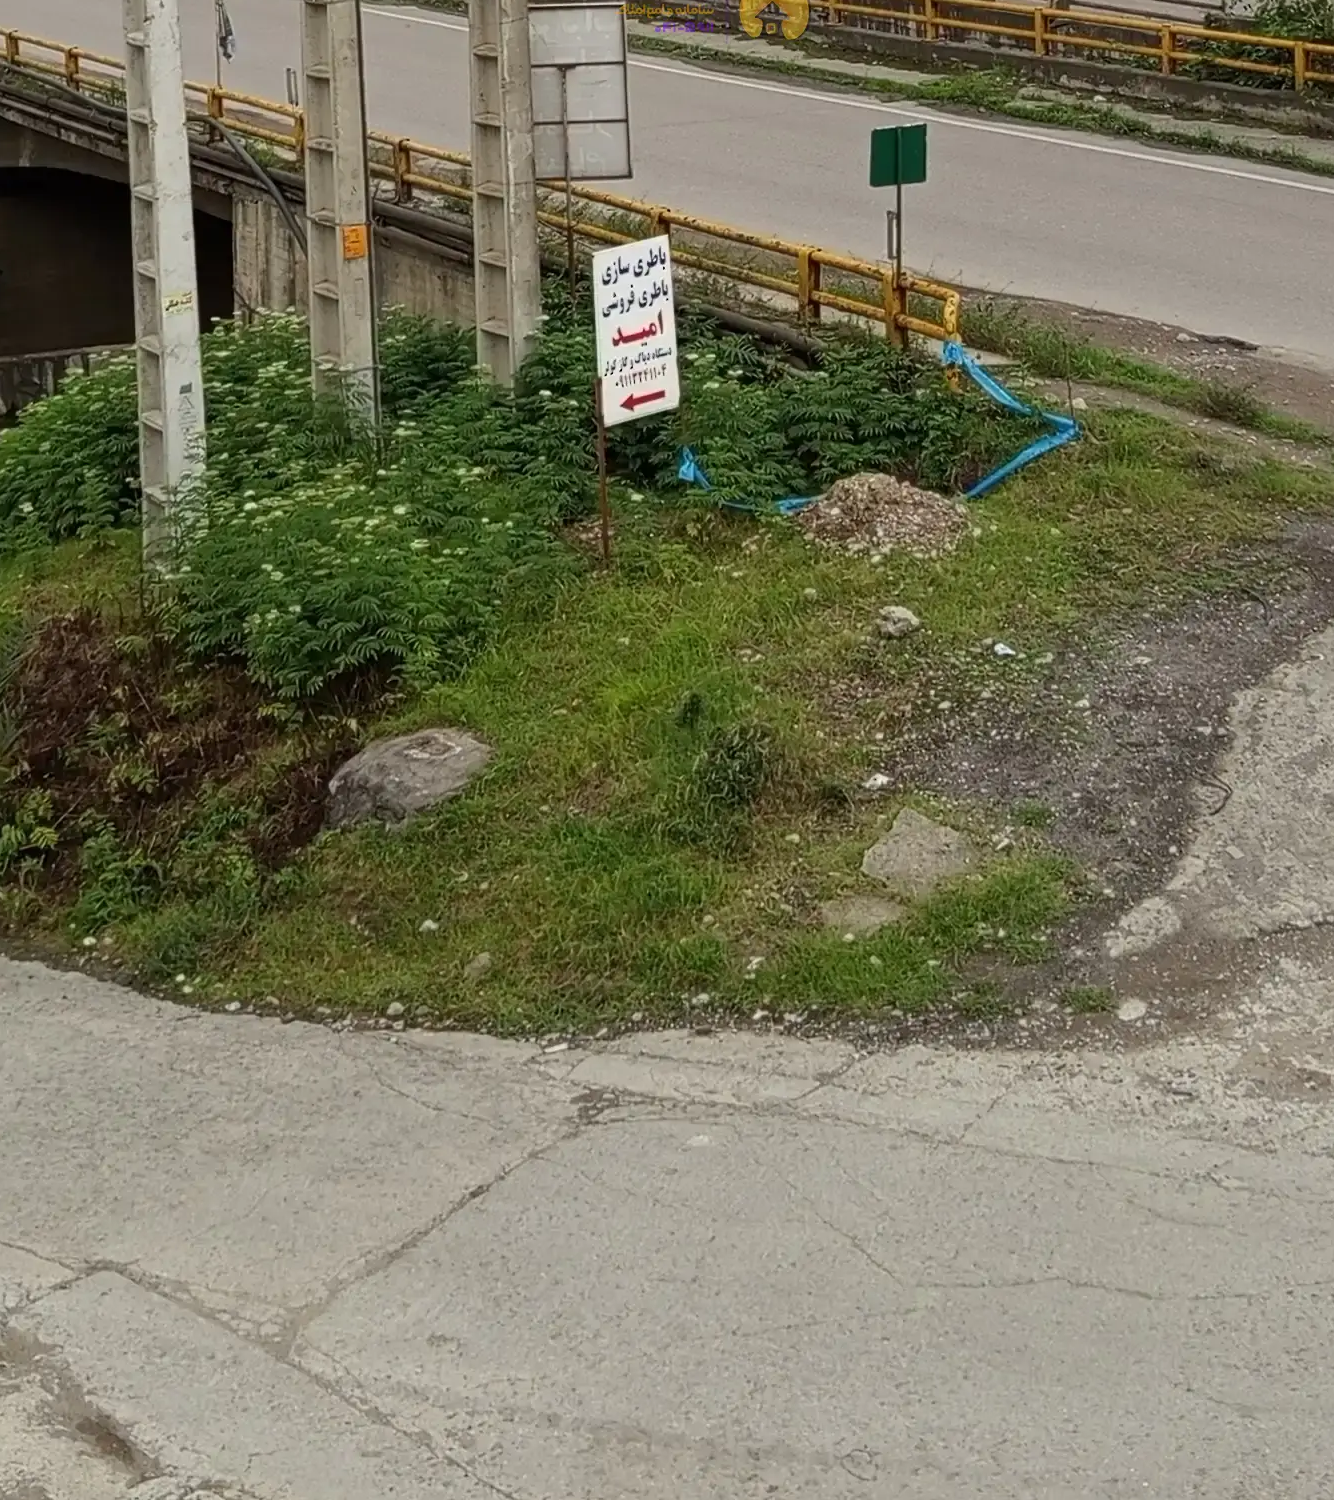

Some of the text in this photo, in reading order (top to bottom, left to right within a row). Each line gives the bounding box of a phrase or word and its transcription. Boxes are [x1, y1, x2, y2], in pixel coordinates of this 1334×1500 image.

[602, 246, 666, 286] باطری سازی
[602, 279, 669, 318] باطری فروشی
[612, 309, 664, 347] امید
